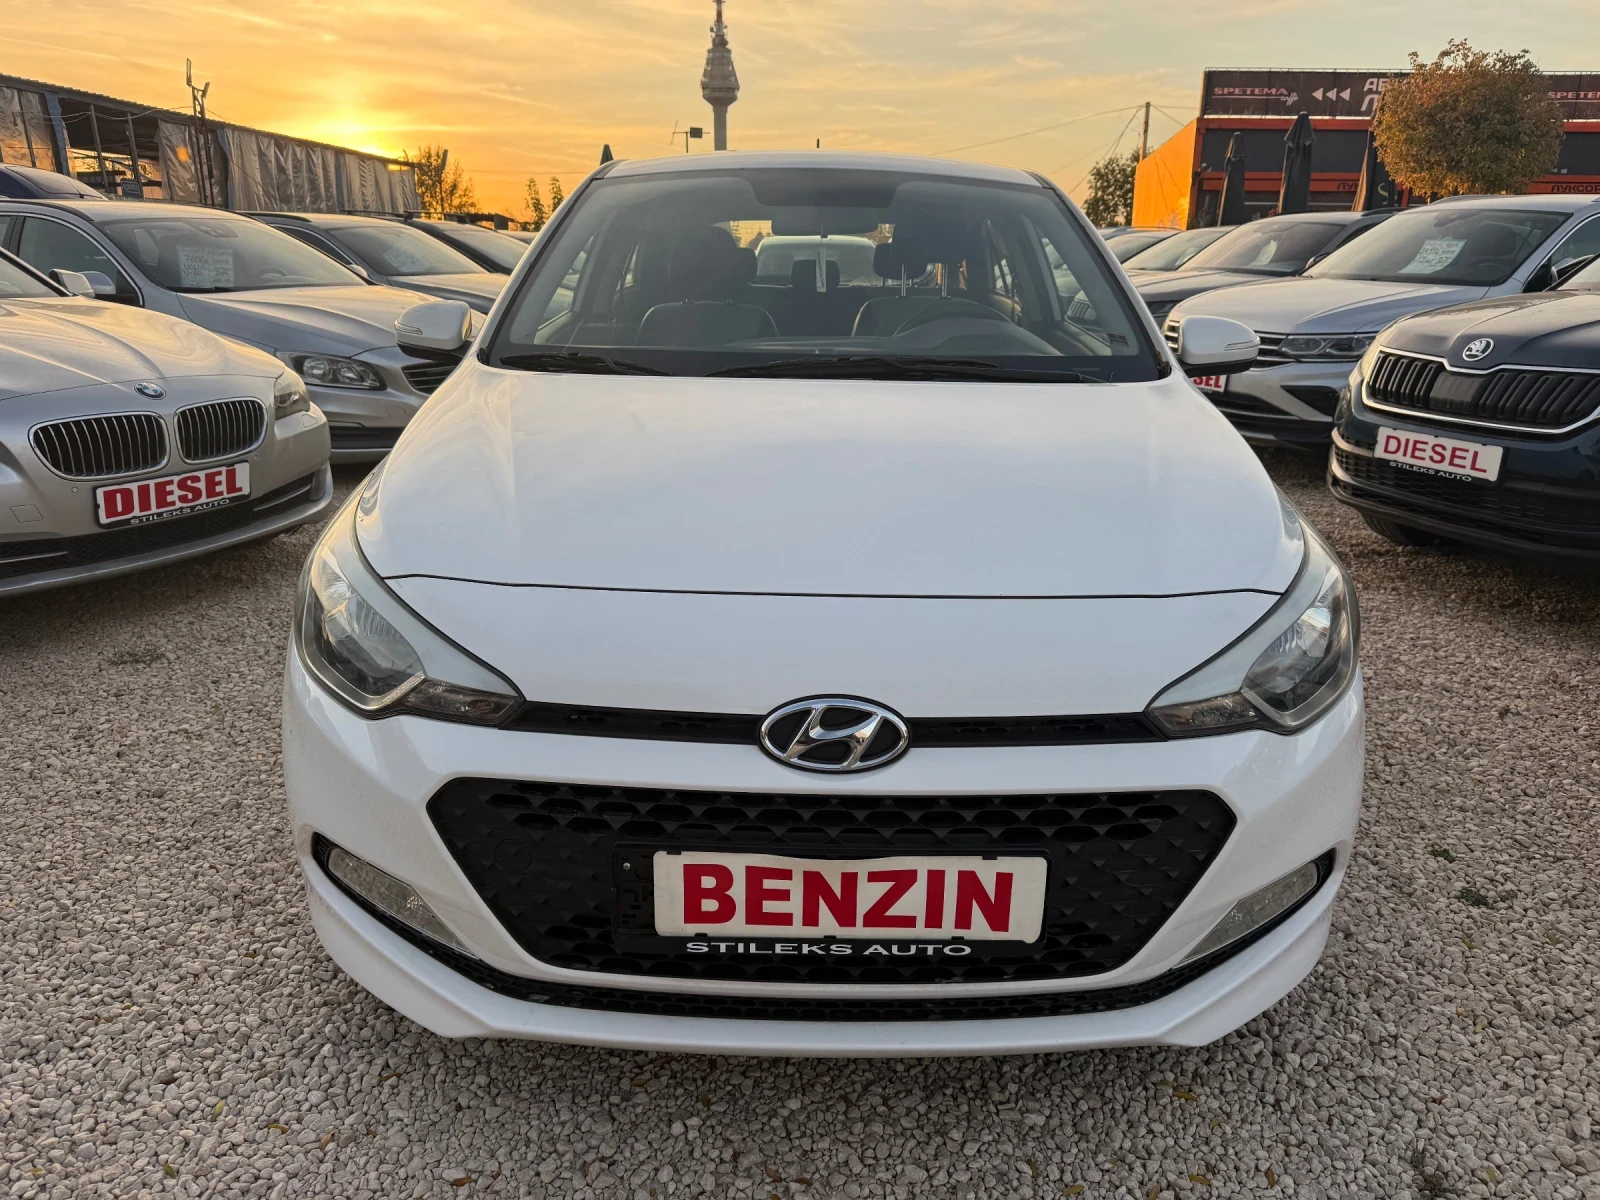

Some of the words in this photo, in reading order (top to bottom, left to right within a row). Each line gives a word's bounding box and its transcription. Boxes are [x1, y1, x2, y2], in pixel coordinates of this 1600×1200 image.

[1213, 87, 1288, 95] SPETEMA
[1383, 434, 1488, 474] DIESEL
[1389, 461, 1436, 475] STILEKS
[1437, 471, 1473, 482] AUTO
[103, 466, 243, 520] DIESEL
[130, 507, 191, 525] STILEKS
[194, 499, 230, 512] AUTO
[682, 863, 1014, 933] BENZIN
[685, 942, 853, 955] STILEKS
[862, 944, 972, 956] AUTO
